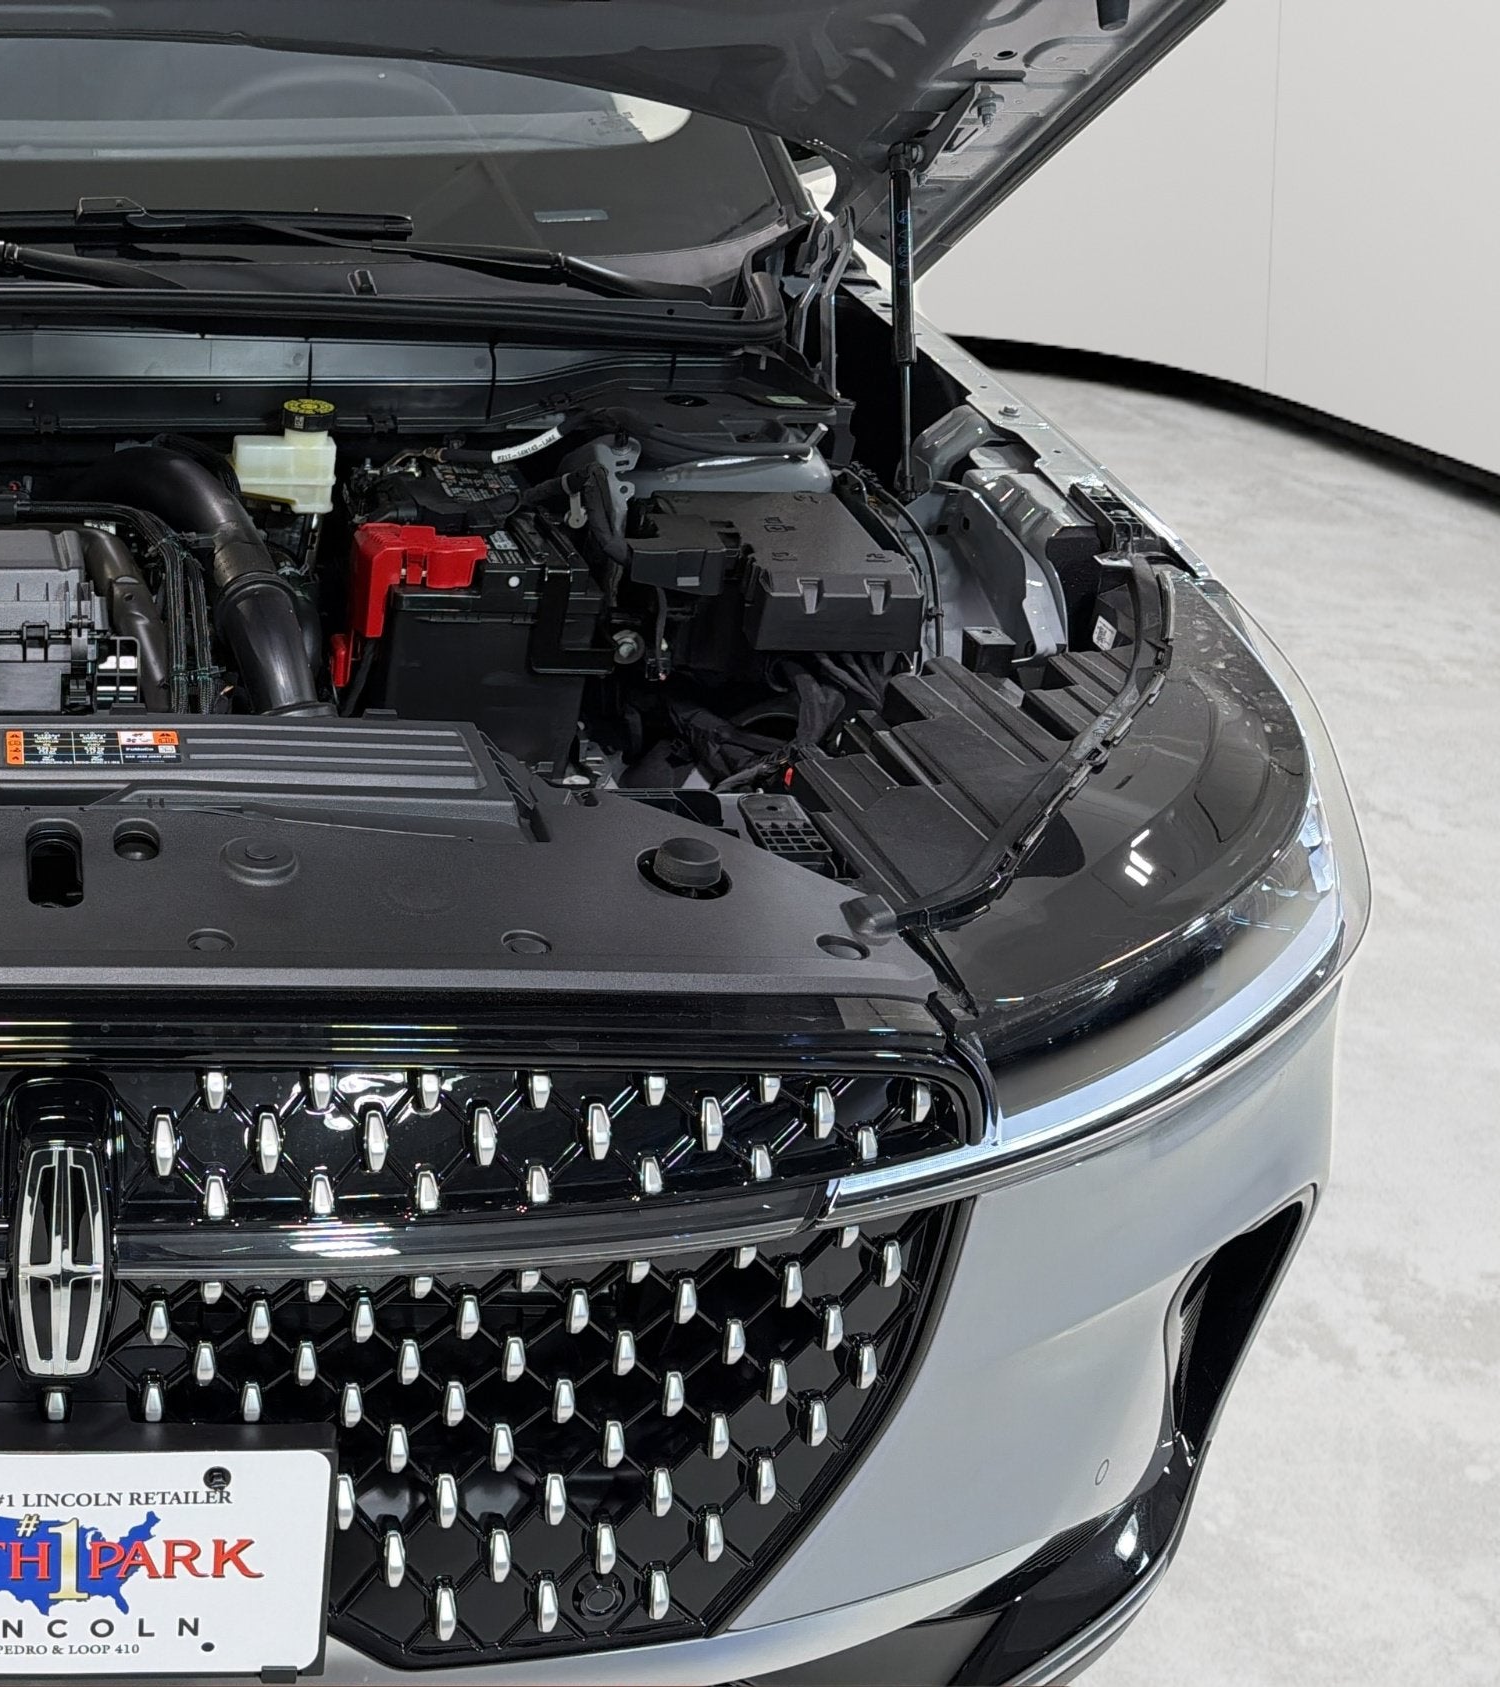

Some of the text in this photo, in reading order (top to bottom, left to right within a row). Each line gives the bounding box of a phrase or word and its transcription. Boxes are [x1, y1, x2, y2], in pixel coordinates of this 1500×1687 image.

[22, 1492, 122, 1508] LINCOLN
[128, 1490, 233, 1506] RETAILER
[89, 1538, 265, 1580] PARK
[51, 1644, 63, 1655] &
[68, 1644, 111, 1655] LOOP
[114, 1643, 140, 1654] 410
